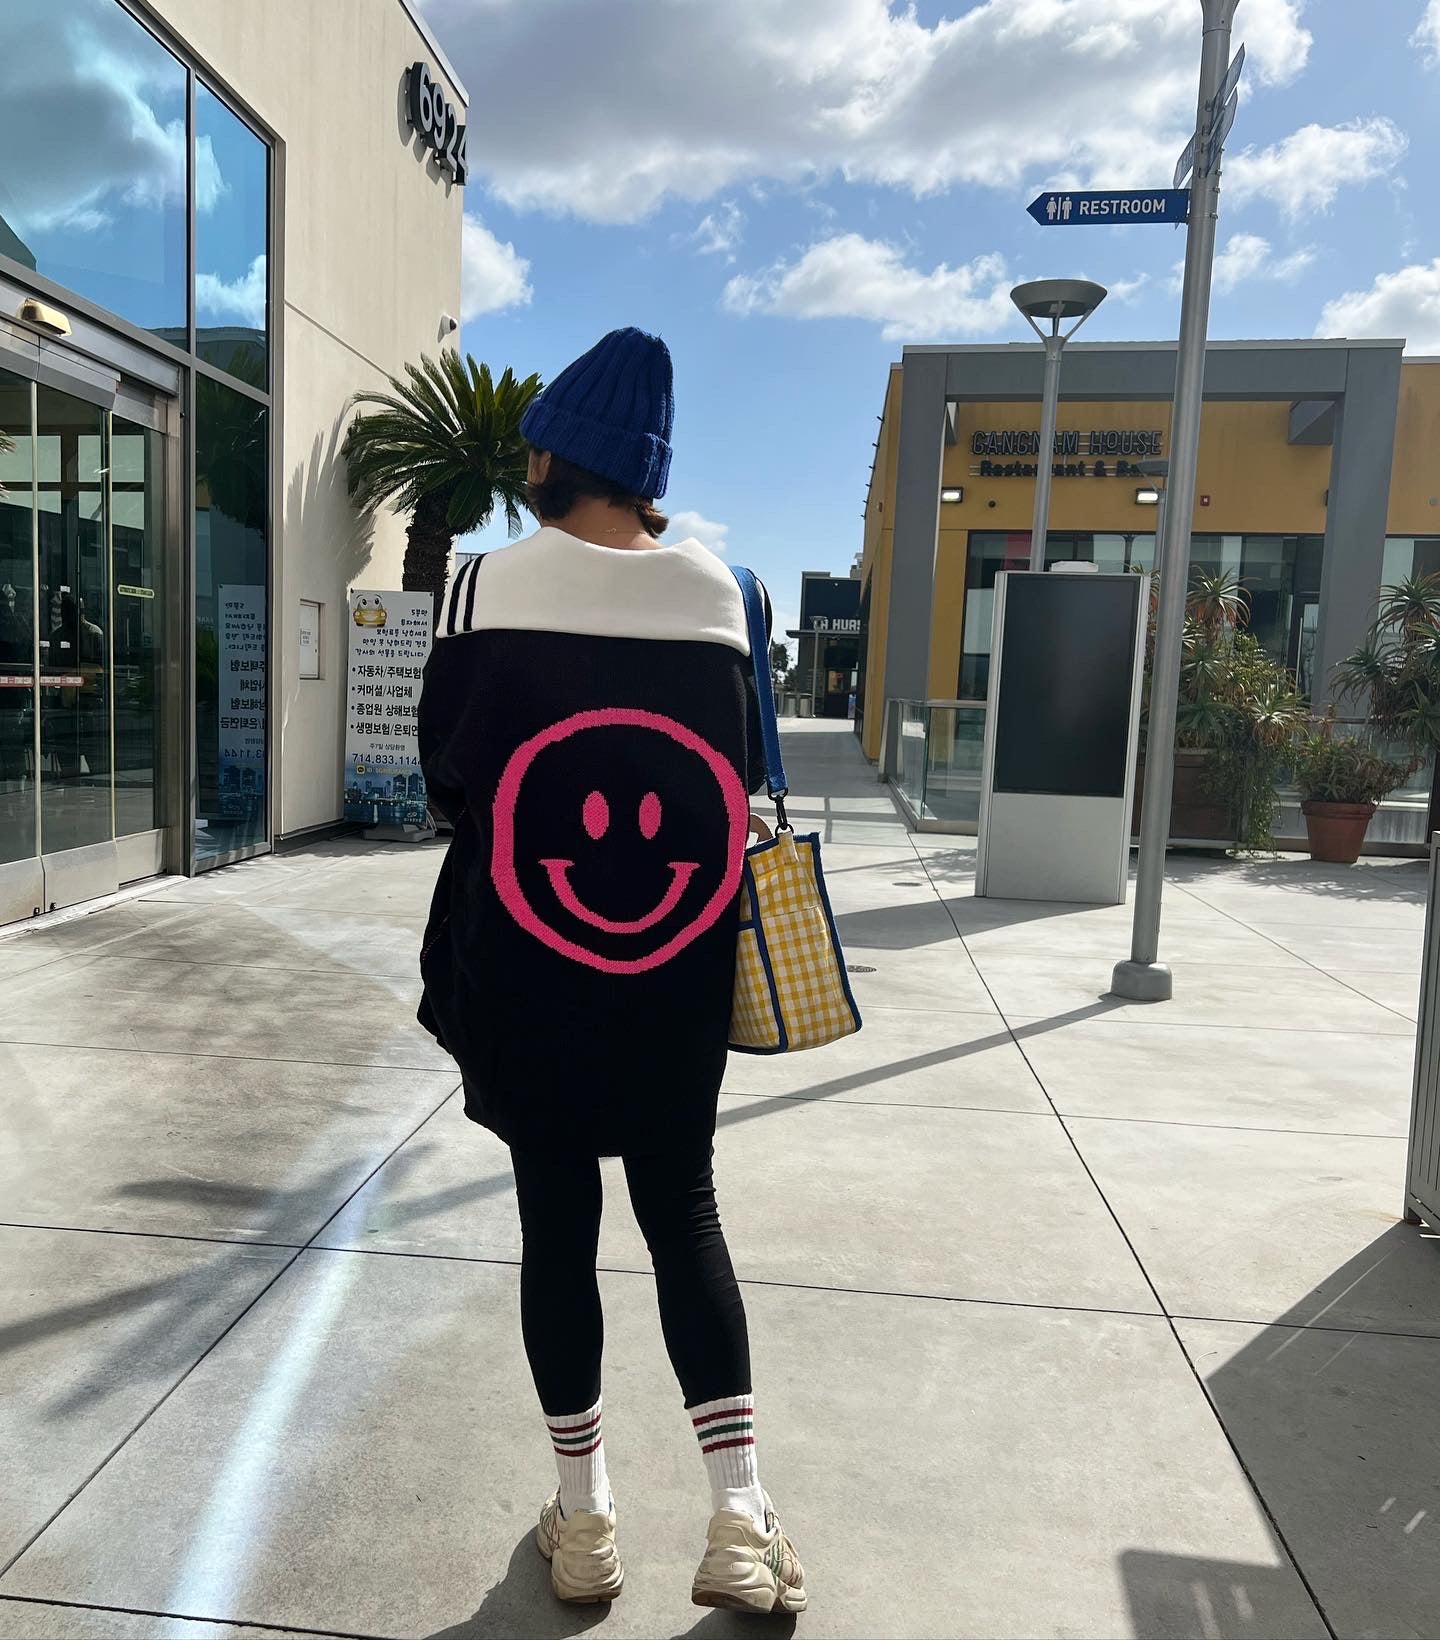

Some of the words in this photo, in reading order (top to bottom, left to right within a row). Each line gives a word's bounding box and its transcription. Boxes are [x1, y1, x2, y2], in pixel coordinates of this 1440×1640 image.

[411, 62, 468, 185] 6924
[1079, 198, 1166, 215] RESTROOM
[1090, 431, 1163, 455] HOUSE
[980, 461, 1086, 476] Restaant
[357, 665, 421, 679] 자동차/주택보험
[357, 684, 413, 698] 커머셜/사업체
[356, 702, 383, 716] 종업원
[356, 722, 418, 737] 생명보험/은퇴연
